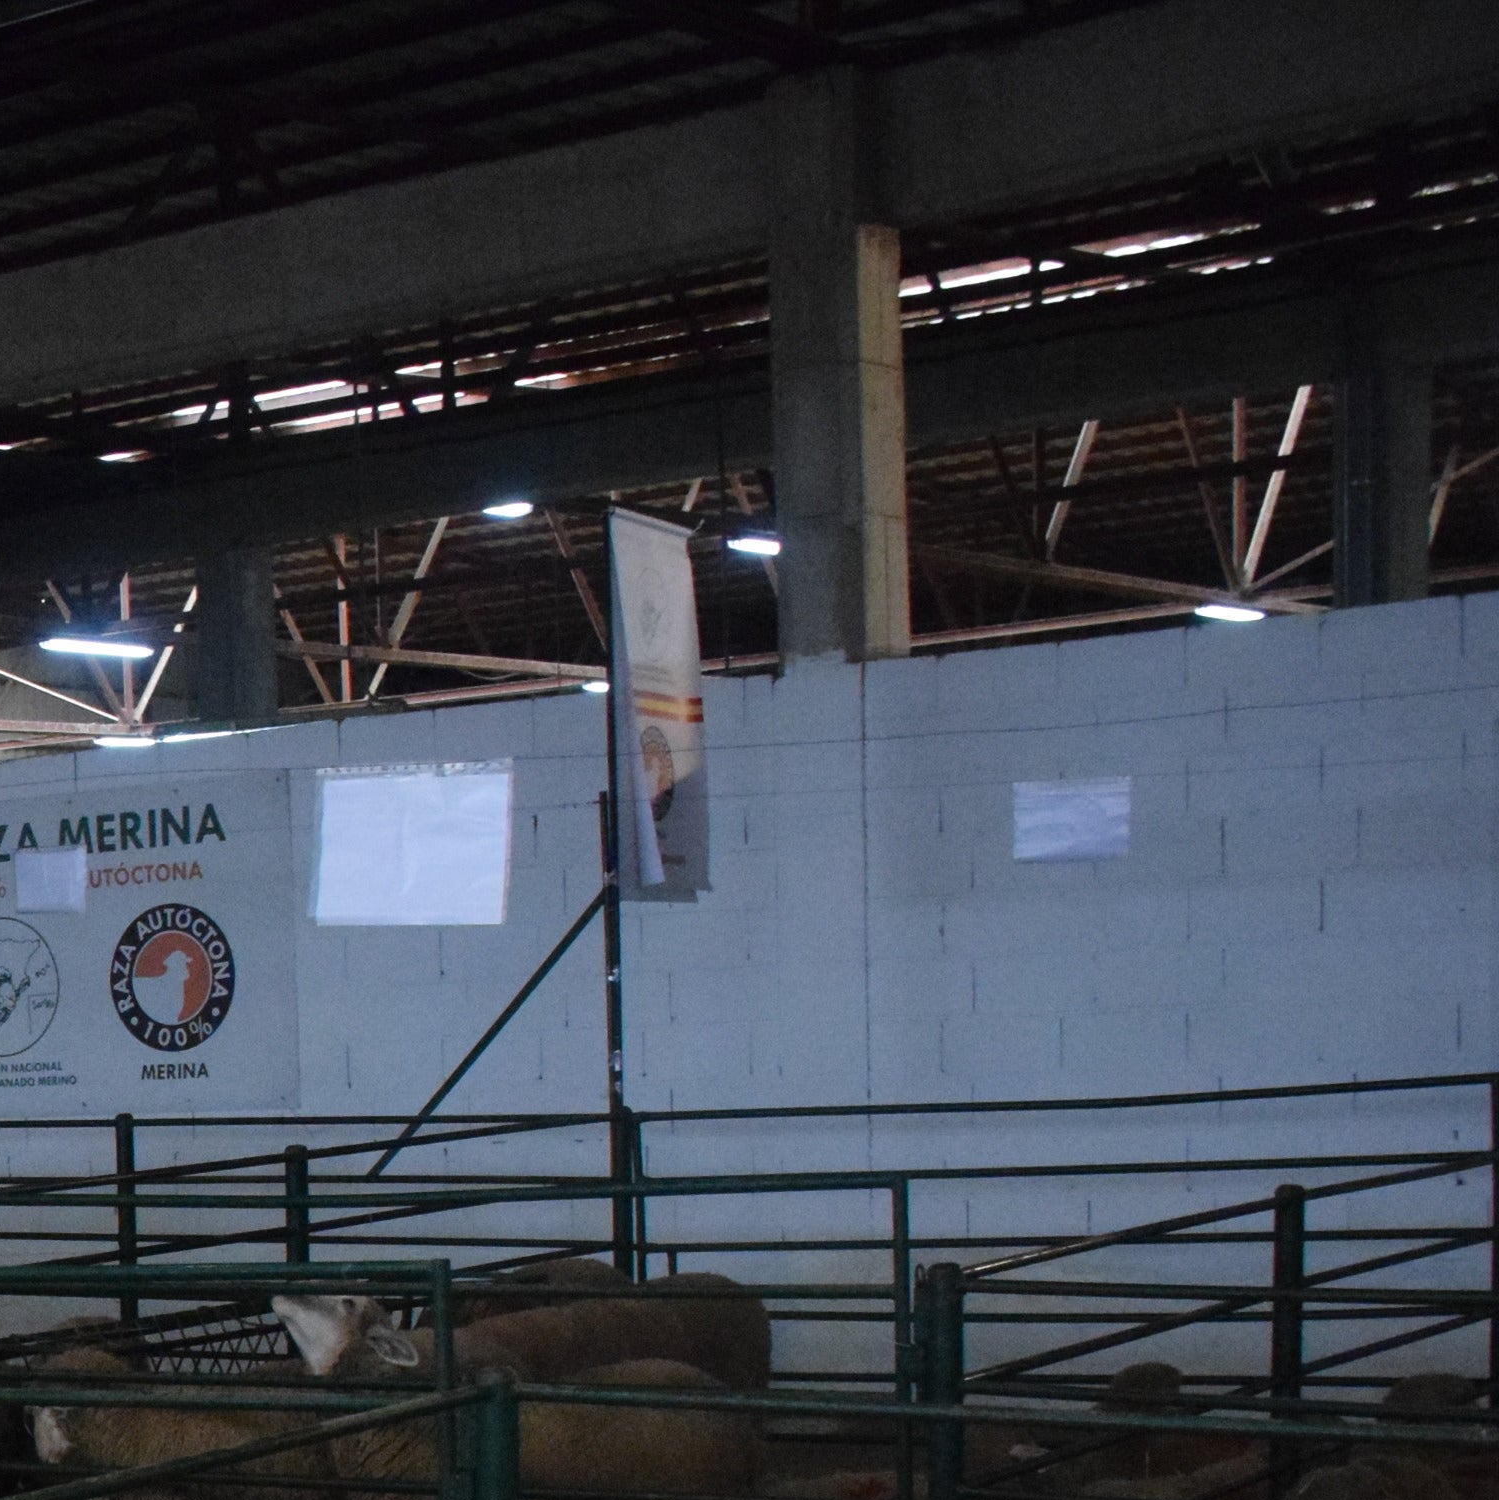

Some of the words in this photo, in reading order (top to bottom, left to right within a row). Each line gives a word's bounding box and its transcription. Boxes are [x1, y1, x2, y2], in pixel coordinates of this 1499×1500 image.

[58, 803, 227, 855] MERINA
[84, 860, 204, 890] UTÓCTONA
[113, 944, 138, 1015] RAZA
[136, 907, 232, 999] AUTÓCTONA
[143, 1017, 214, 1047] 100%
[10, 1060, 63, 1073] NACIONAL
[37, 1074, 78, 1087] MERINO
[140, 1062, 209, 1081] MERINA
